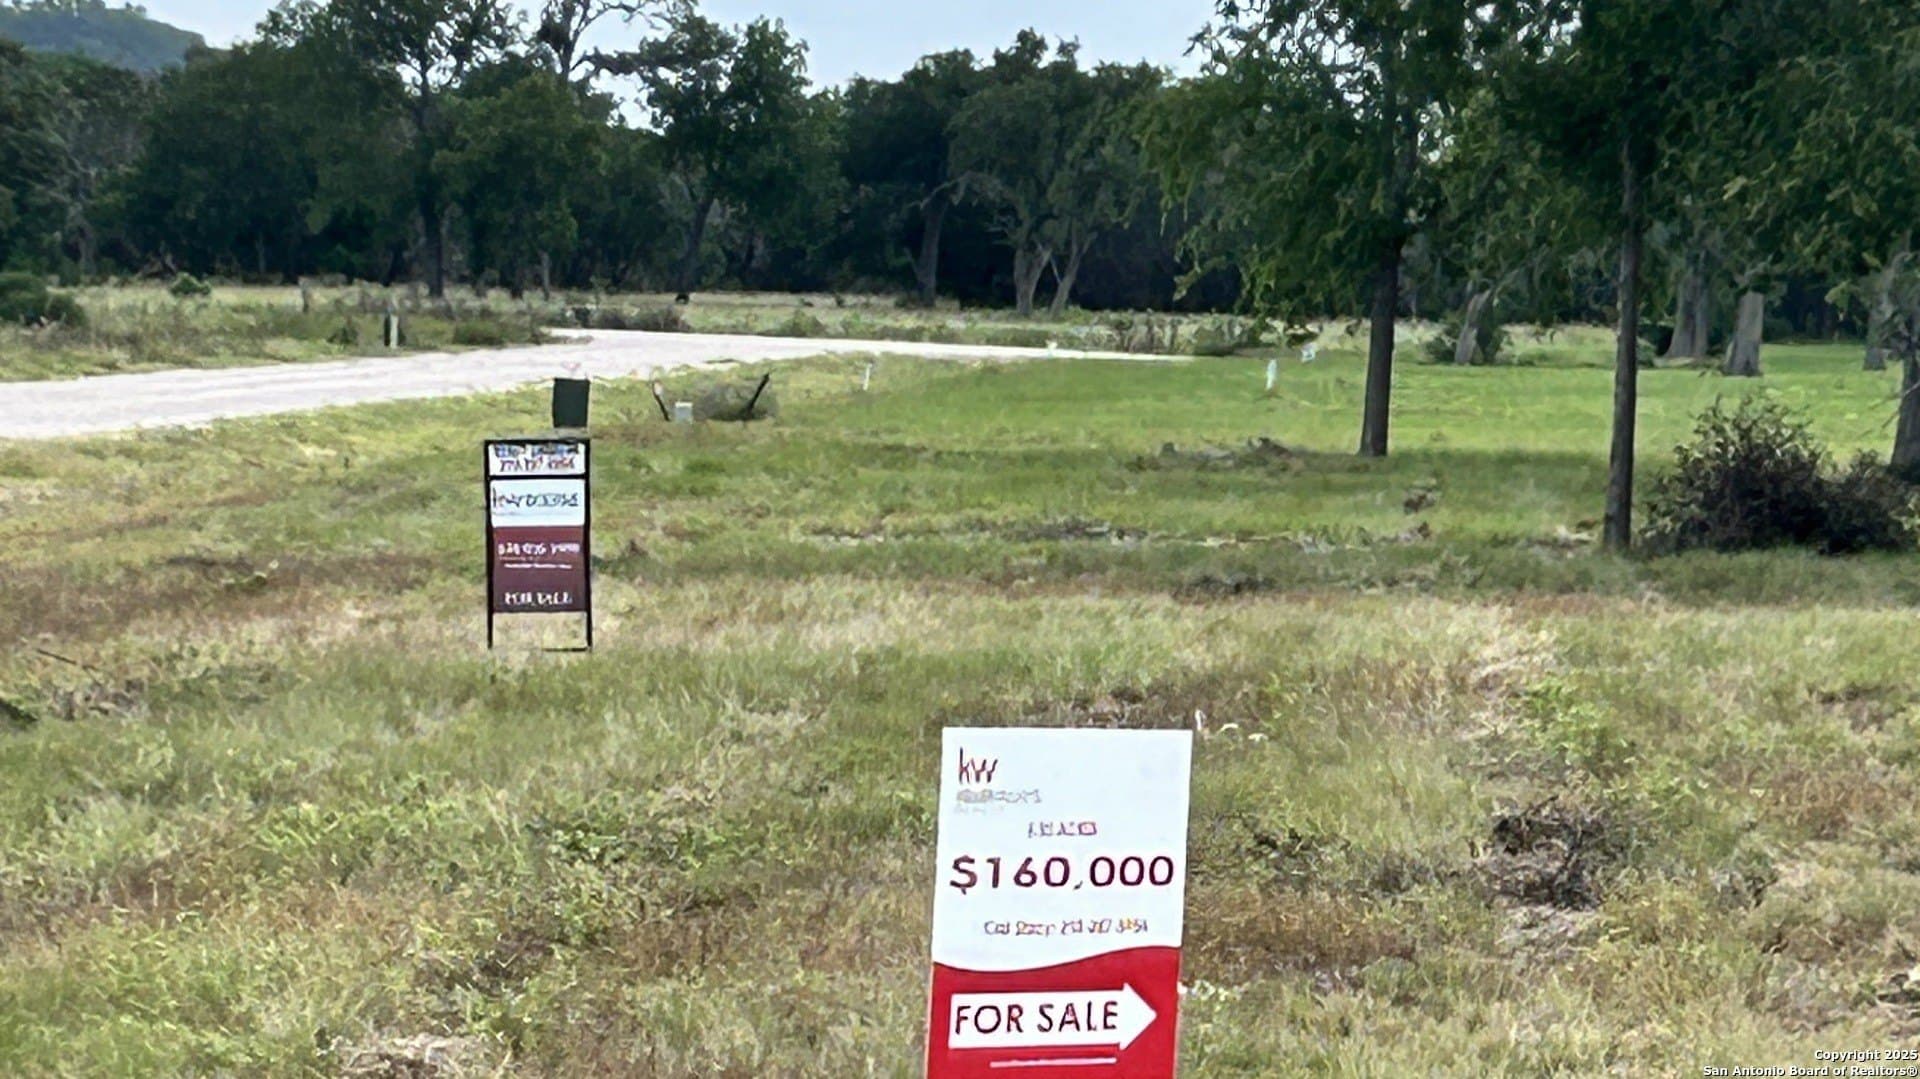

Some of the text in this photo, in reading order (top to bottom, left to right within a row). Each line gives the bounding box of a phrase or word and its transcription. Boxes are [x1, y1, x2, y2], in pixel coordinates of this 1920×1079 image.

[958, 746, 999, 784] kw
[949, 854, 1175, 894] $160,000
[955, 1000, 1119, 1035] FOR SALE
